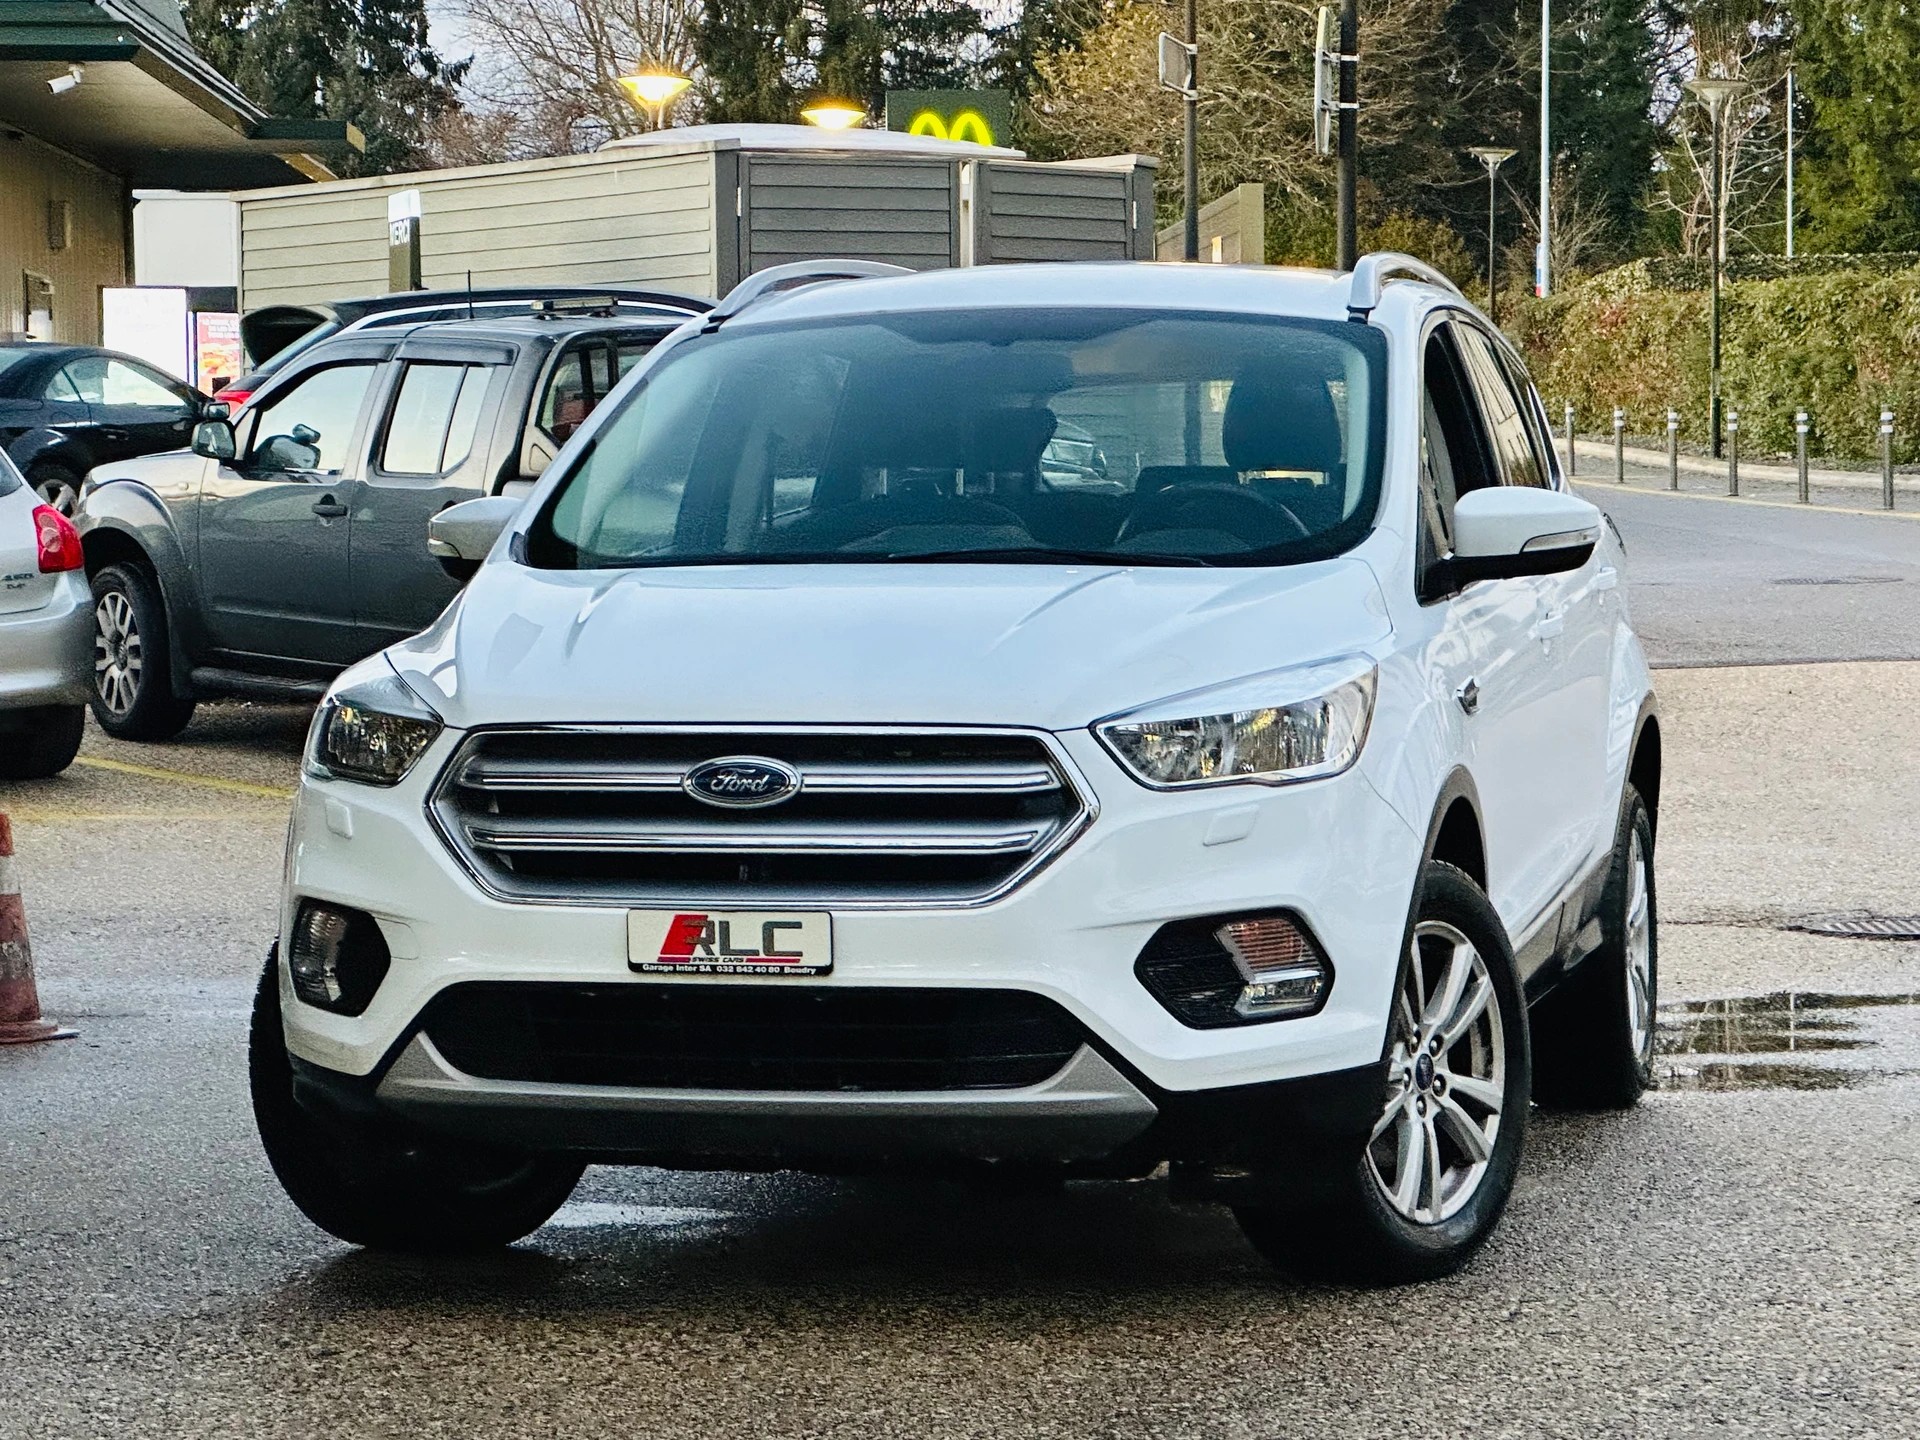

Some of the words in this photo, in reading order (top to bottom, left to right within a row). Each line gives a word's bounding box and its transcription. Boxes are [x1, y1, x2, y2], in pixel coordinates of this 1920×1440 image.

[710, 768, 769, 792] Ford
[642, 964, 673, 973] Garage
[676, 964, 697, 972] Inter
[717, 965, 734, 973] 032
[784, 966, 816, 975] Boudry
